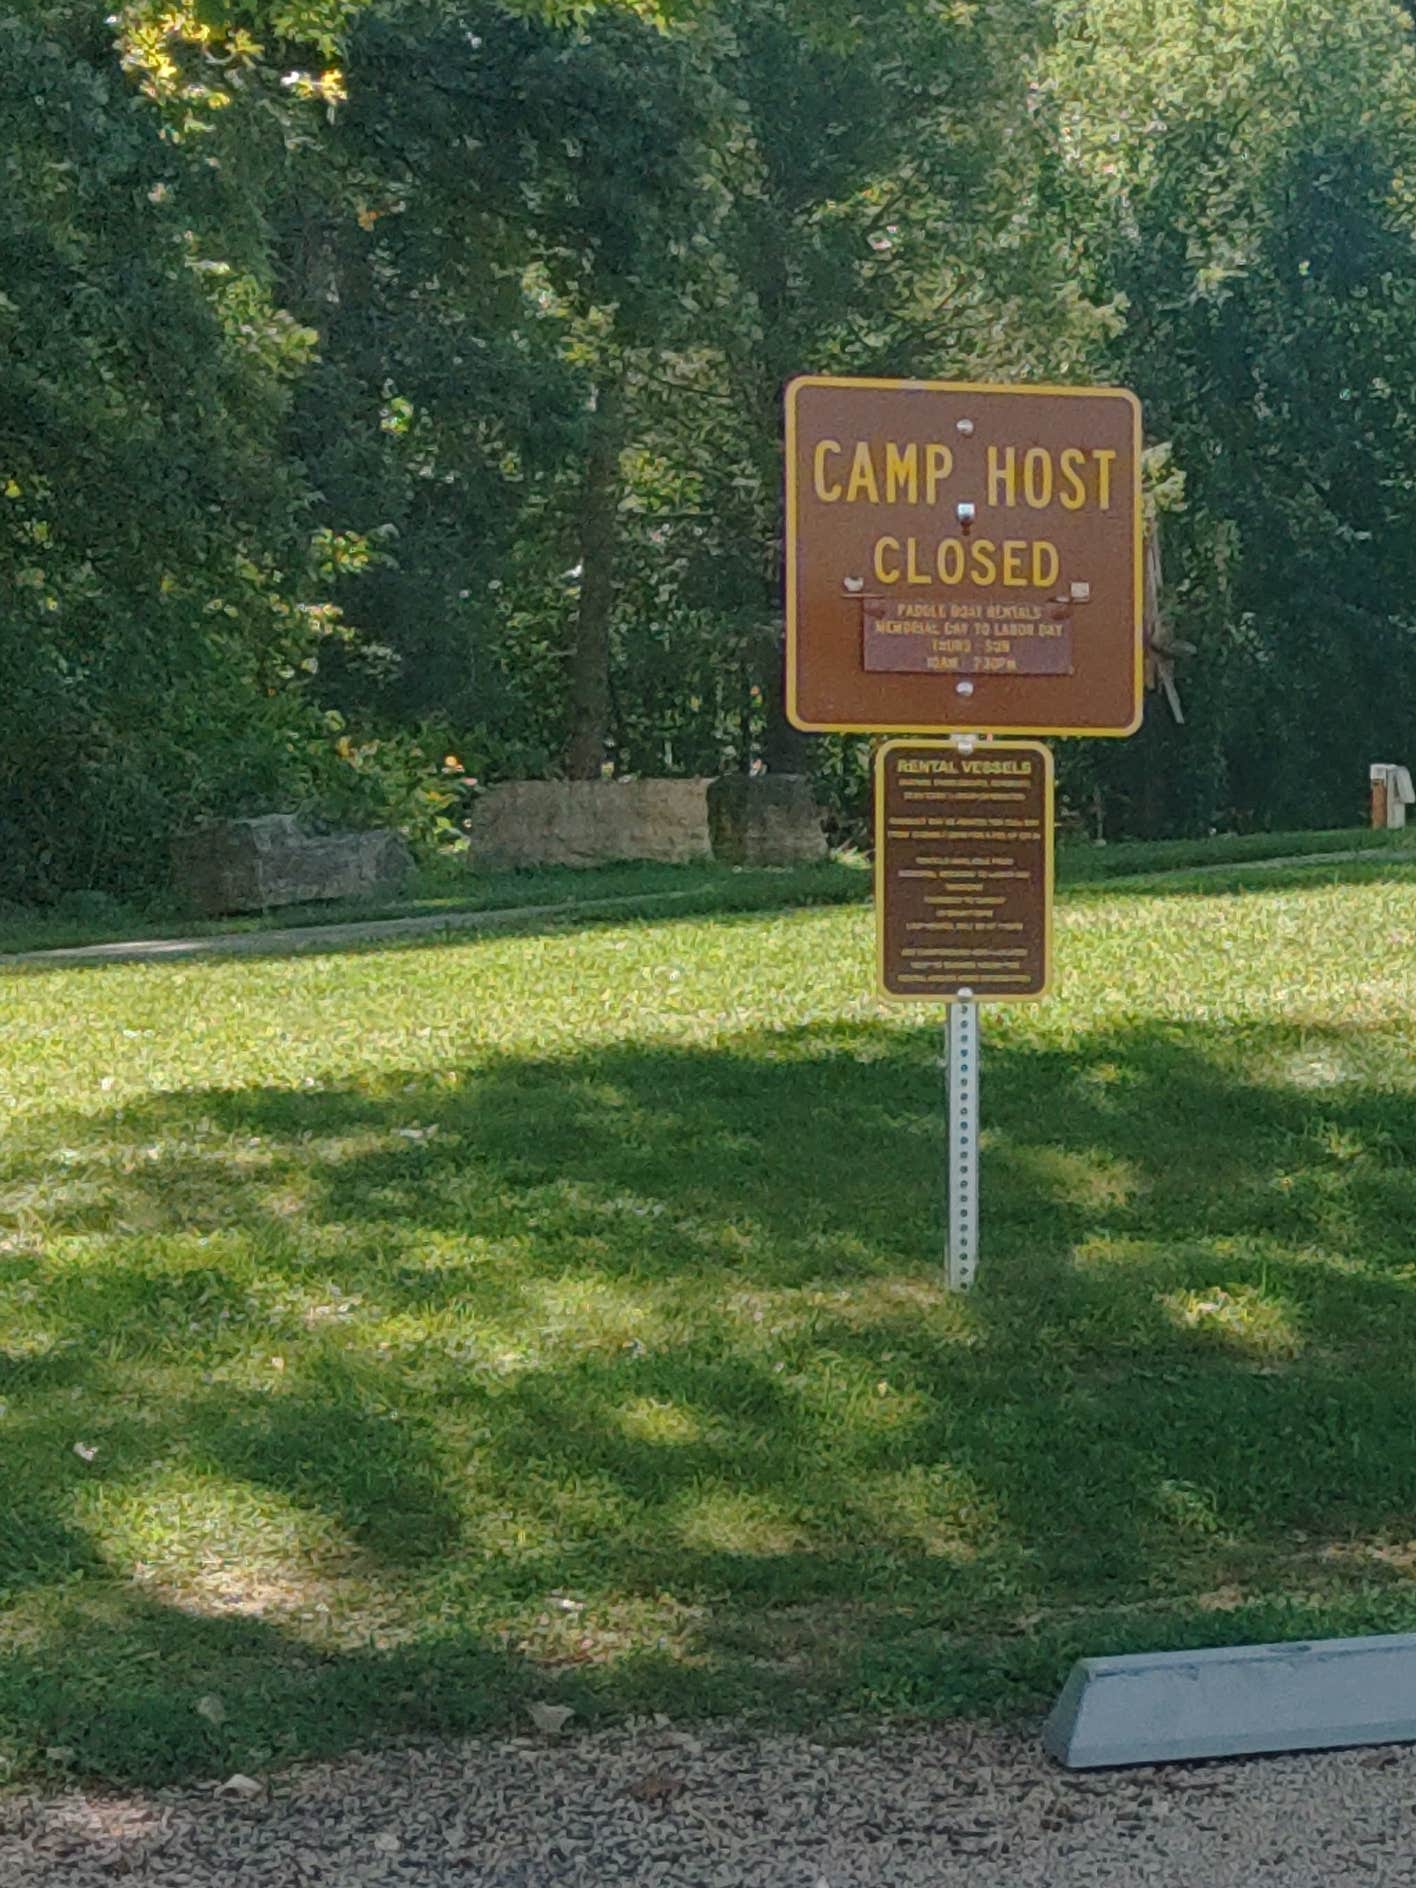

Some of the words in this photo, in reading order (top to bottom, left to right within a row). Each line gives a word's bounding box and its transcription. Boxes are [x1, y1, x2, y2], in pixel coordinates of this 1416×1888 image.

[813, 439, 954, 505] CAMP
[987, 446, 1116, 511] HOST
[873, 536, 1060, 588] CLOSED
[975, 621, 990, 636] TO
[994, 622, 1034, 637] LABOR
[1038, 623, 1062, 638] DAY
[897, 759, 959, 774] RENTAL
[961, 760, 1032, 775] VESSELS
